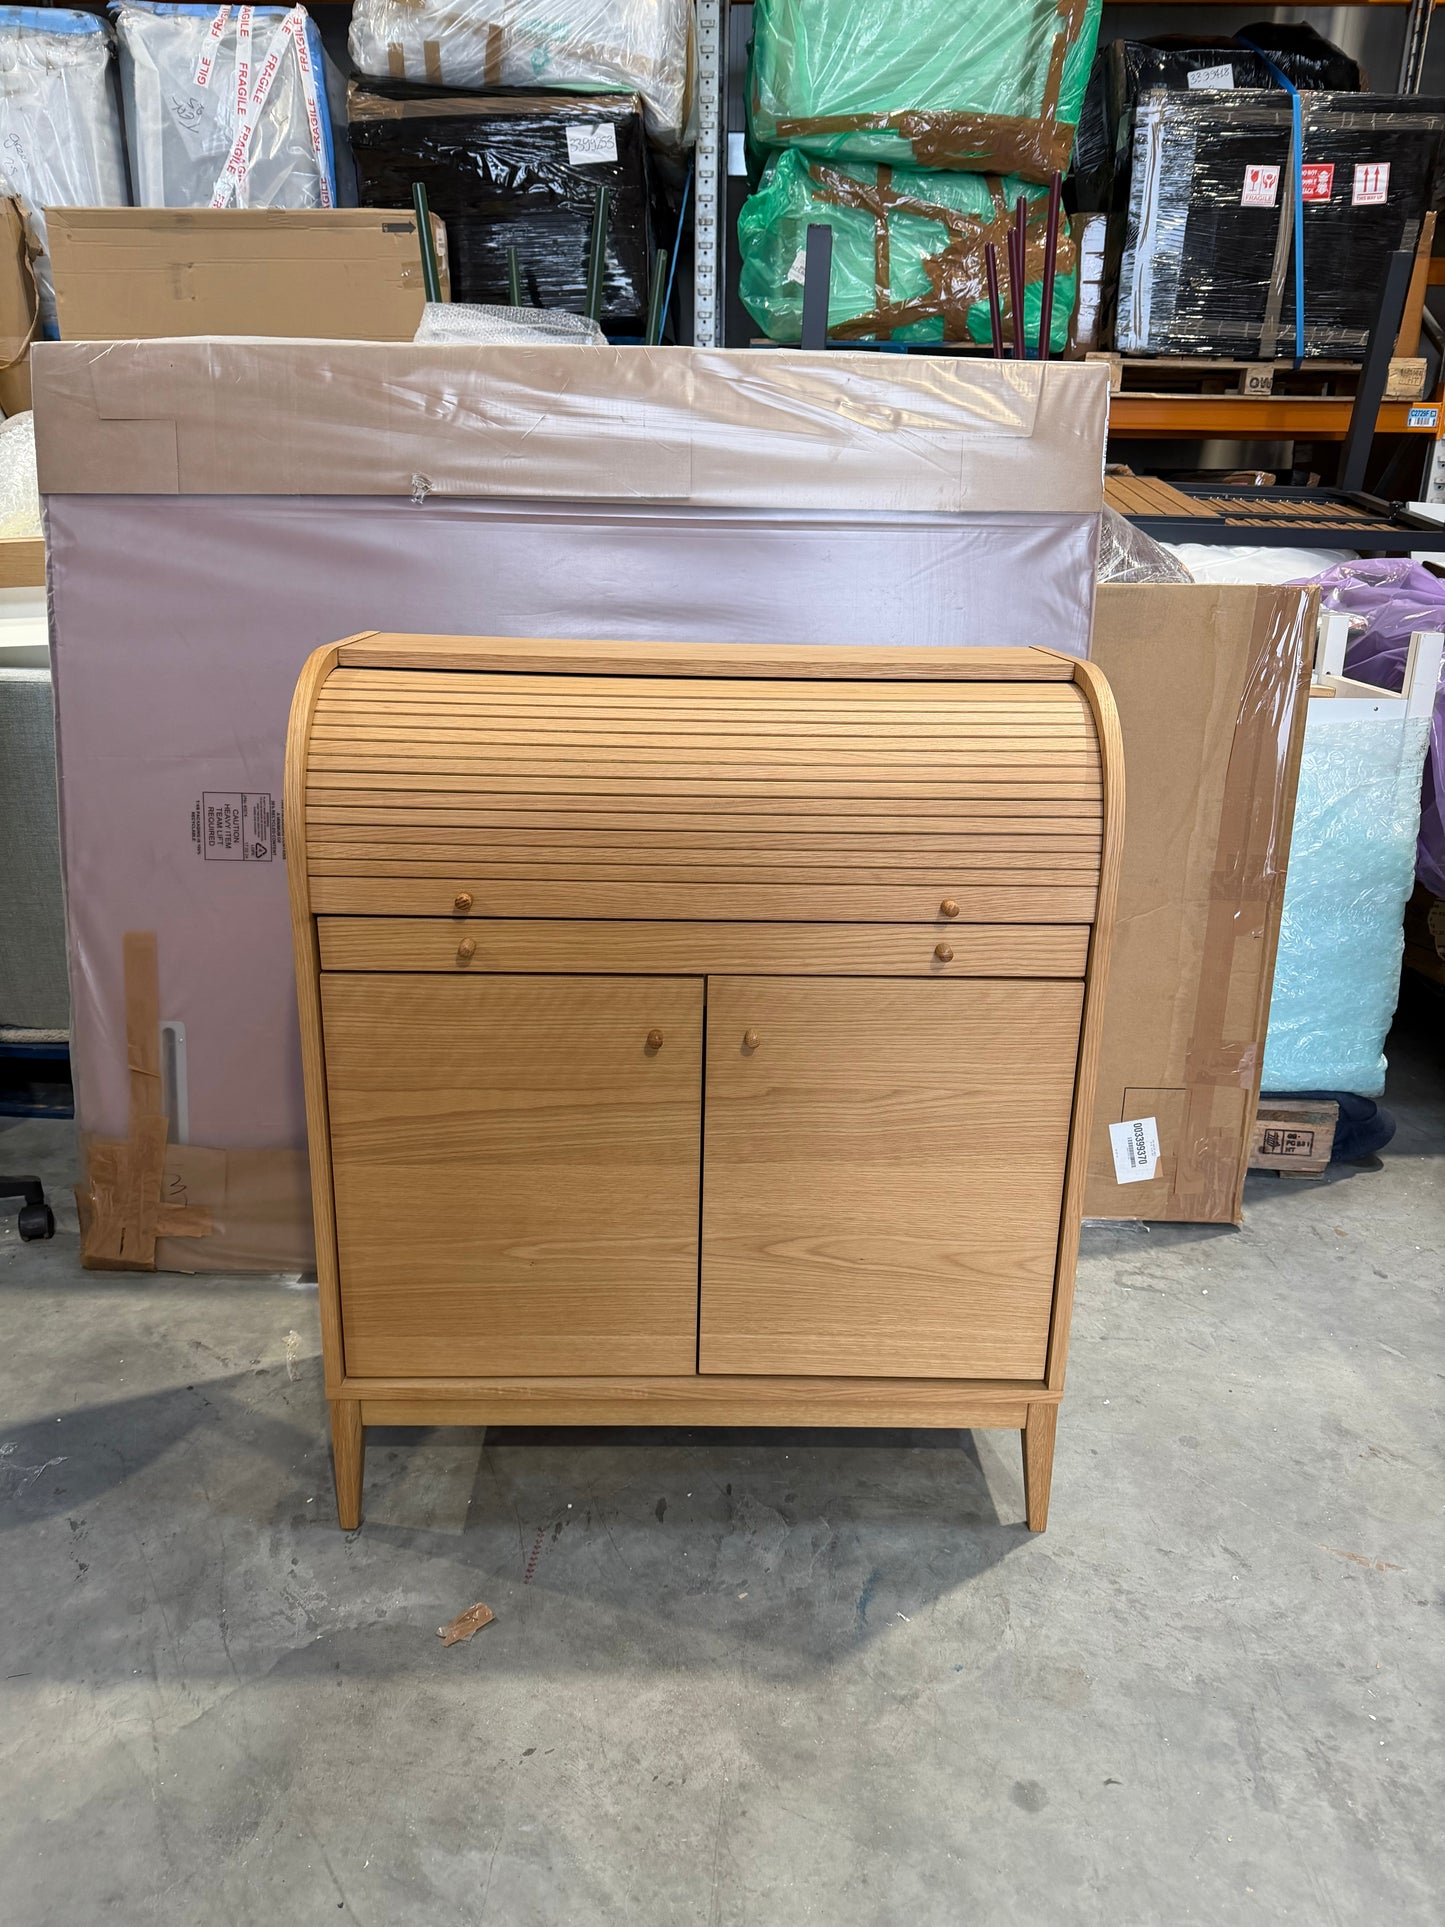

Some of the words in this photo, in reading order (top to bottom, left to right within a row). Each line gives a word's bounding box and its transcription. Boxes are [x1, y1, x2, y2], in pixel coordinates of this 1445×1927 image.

[237, 62, 248, 116] FRAGILE
[253, 53, 278, 104] FRAGILE
[294, 17, 309, 72] FRAGILE
[307, 98, 321, 152] FRAGILE
[226, 124, 251, 174] FRAGILE
[216, 829, 224, 846] LIFT
[232, 809, 240, 843] CAUTION
[1133, 1122, 1147, 1166] 003399370
